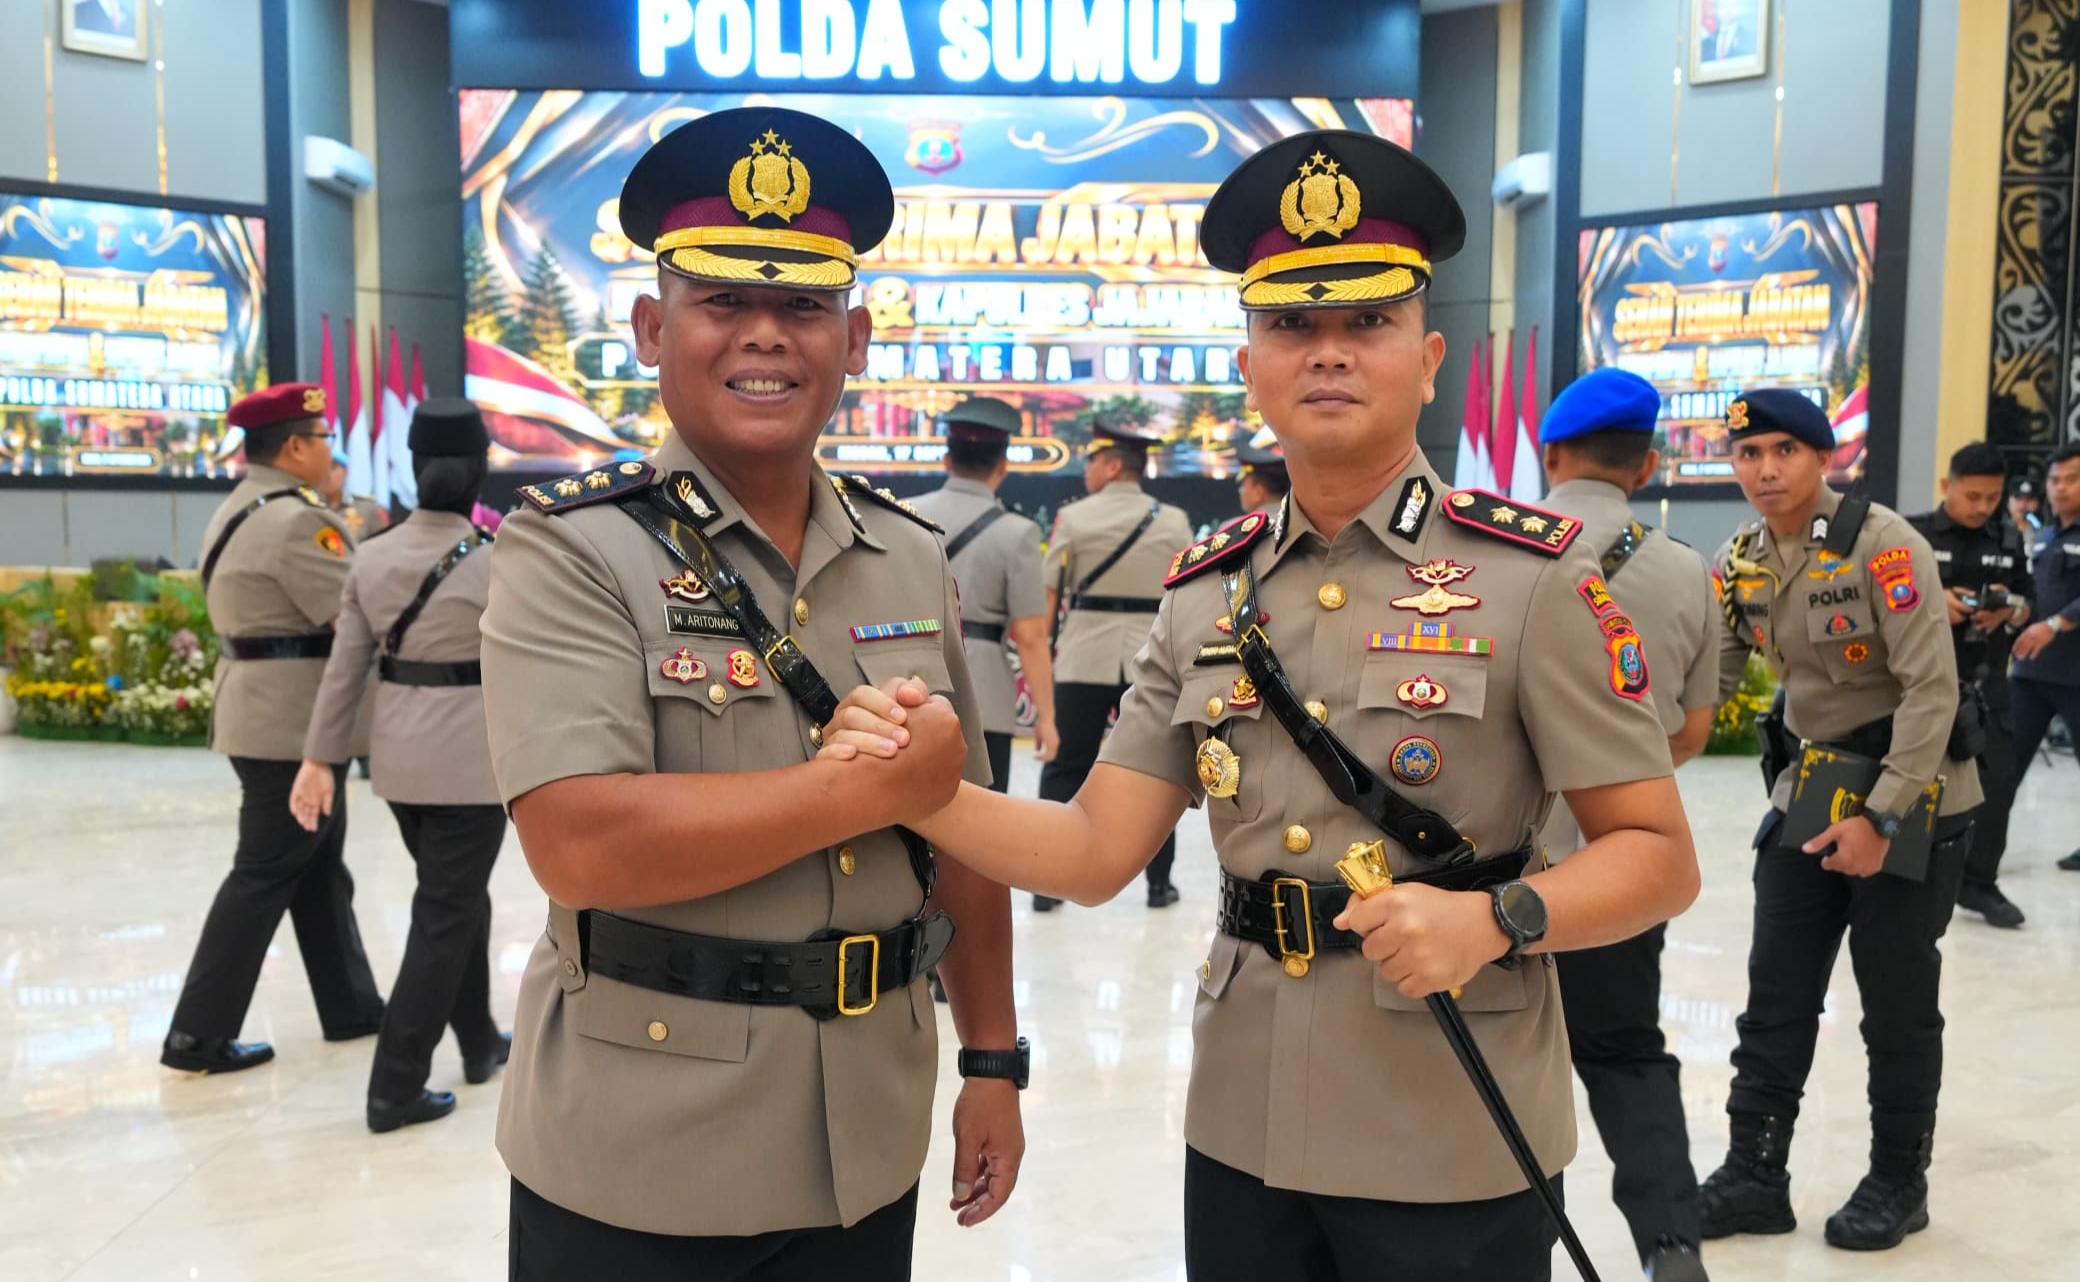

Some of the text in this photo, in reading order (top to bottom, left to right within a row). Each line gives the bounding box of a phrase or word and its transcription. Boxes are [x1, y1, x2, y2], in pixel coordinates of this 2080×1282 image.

[638, 0, 1237, 84] POLDA SUMUT
[1104, 347, 1247, 383] UTAR
[1871, 550, 1908, 571] POLDA
[1808, 586, 1860, 609] POLRI
[687, 614, 739, 631] ARITONANG
[1421, 624, 1440, 636] XVI
